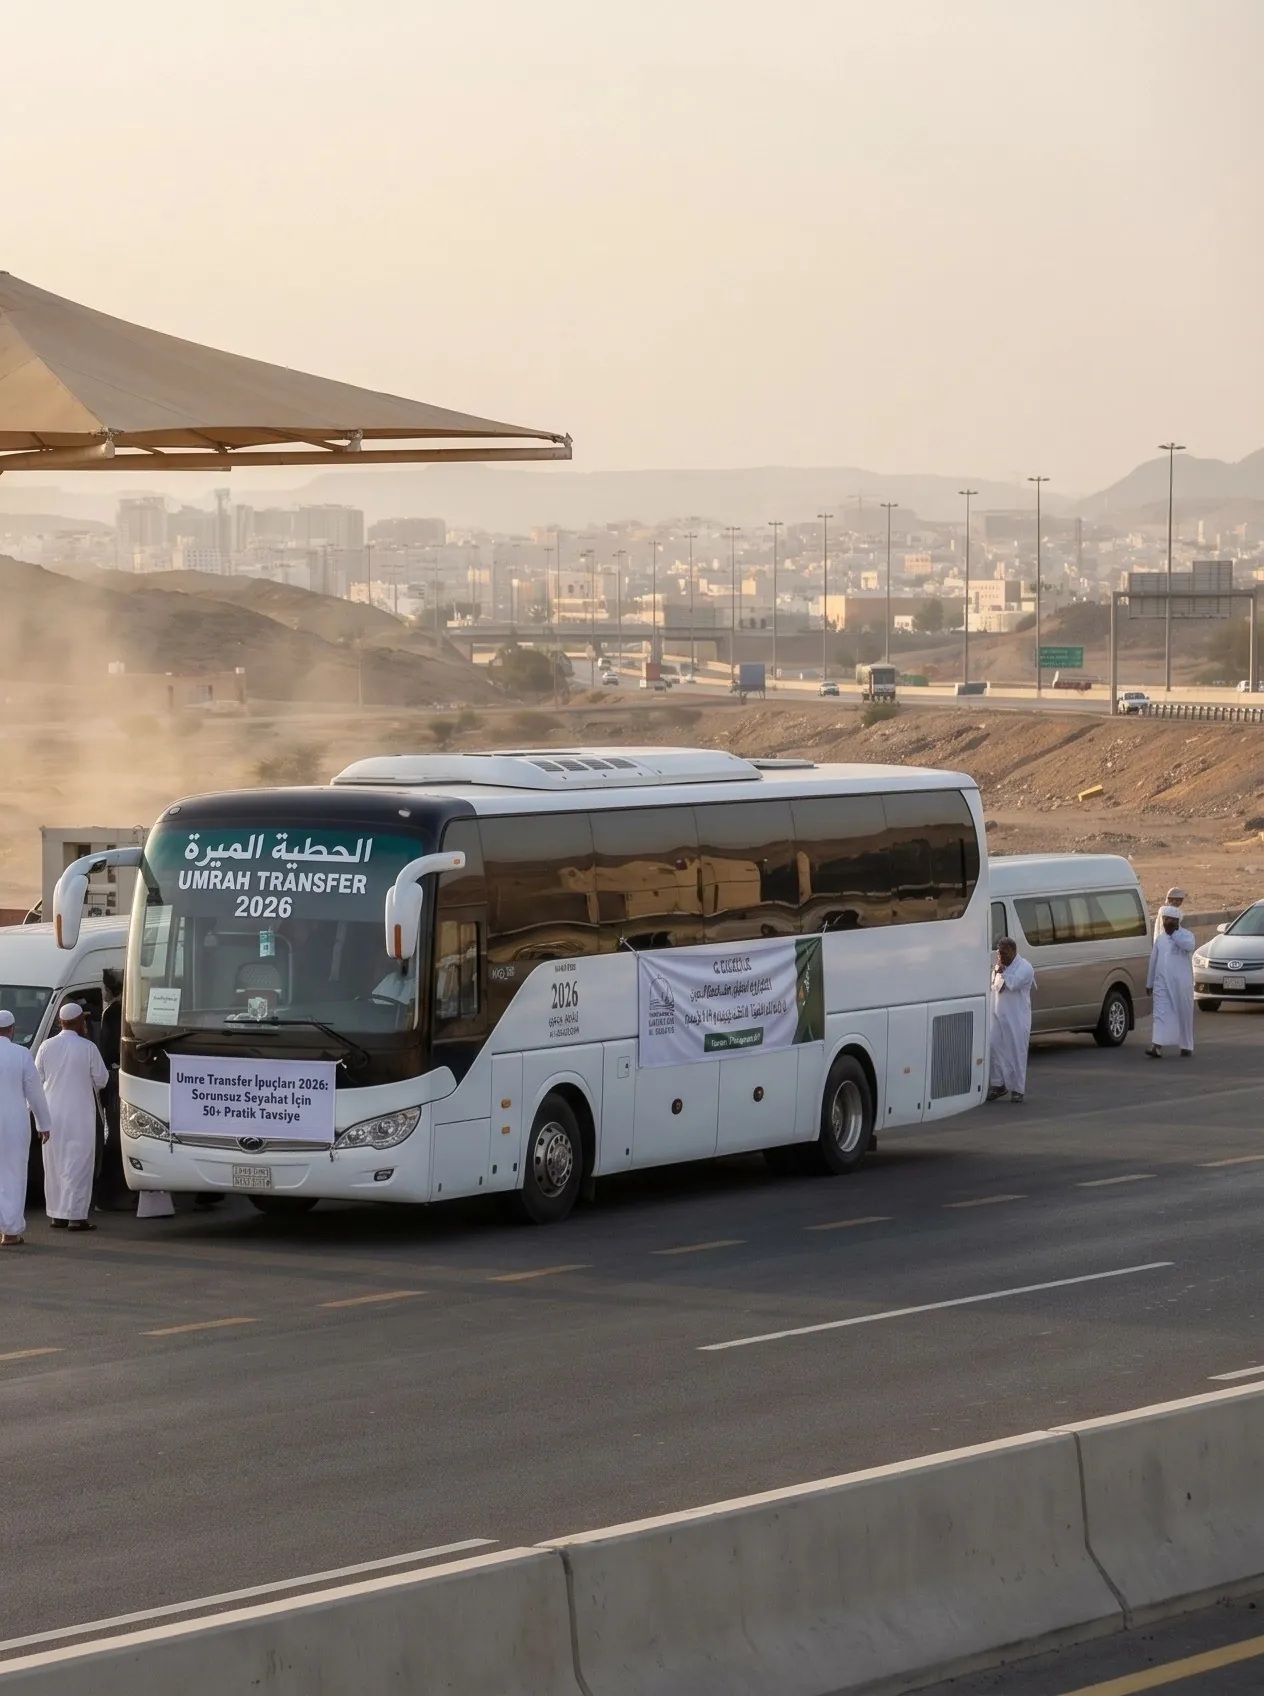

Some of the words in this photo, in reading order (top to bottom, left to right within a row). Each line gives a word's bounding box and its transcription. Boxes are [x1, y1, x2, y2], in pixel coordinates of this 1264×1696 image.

[178, 870, 252, 891] UMRAH
[257, 871, 368, 894] TRANSFER
[234, 895, 293, 918] 2026
[551, 981, 579, 1009] 2026
[176, 1072, 205, 1085] Umre
[207, 1074, 253, 1087] Transfer
[298, 1078, 329, 1090] 2026:
[191, 1089, 242, 1102] Sorunsuz
[244, 1091, 288, 1106] Seyahat
[202, 1105, 221, 1117] 50+
[224, 1106, 256, 1119] Pratik
[259, 1108, 300, 1123] Tavsiye
